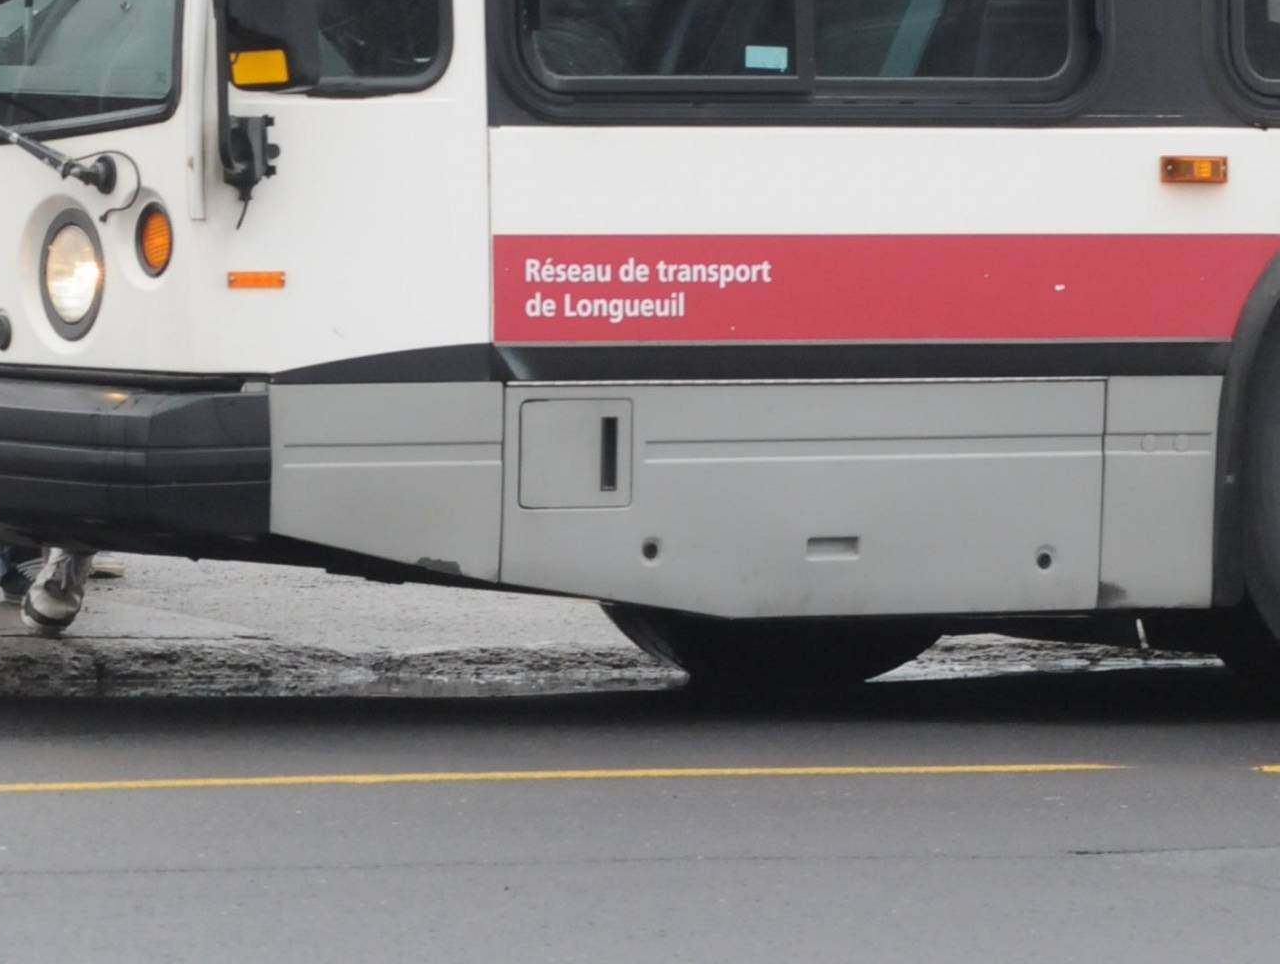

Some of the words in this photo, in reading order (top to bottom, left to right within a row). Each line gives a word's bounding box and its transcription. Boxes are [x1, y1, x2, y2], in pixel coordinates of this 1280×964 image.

[524, 257, 612, 282] Réseau
[619, 257, 650, 282] de
[656, 260, 773, 288] transport
[524, 292, 557, 317] de
[564, 292, 686, 323] Longueuil
